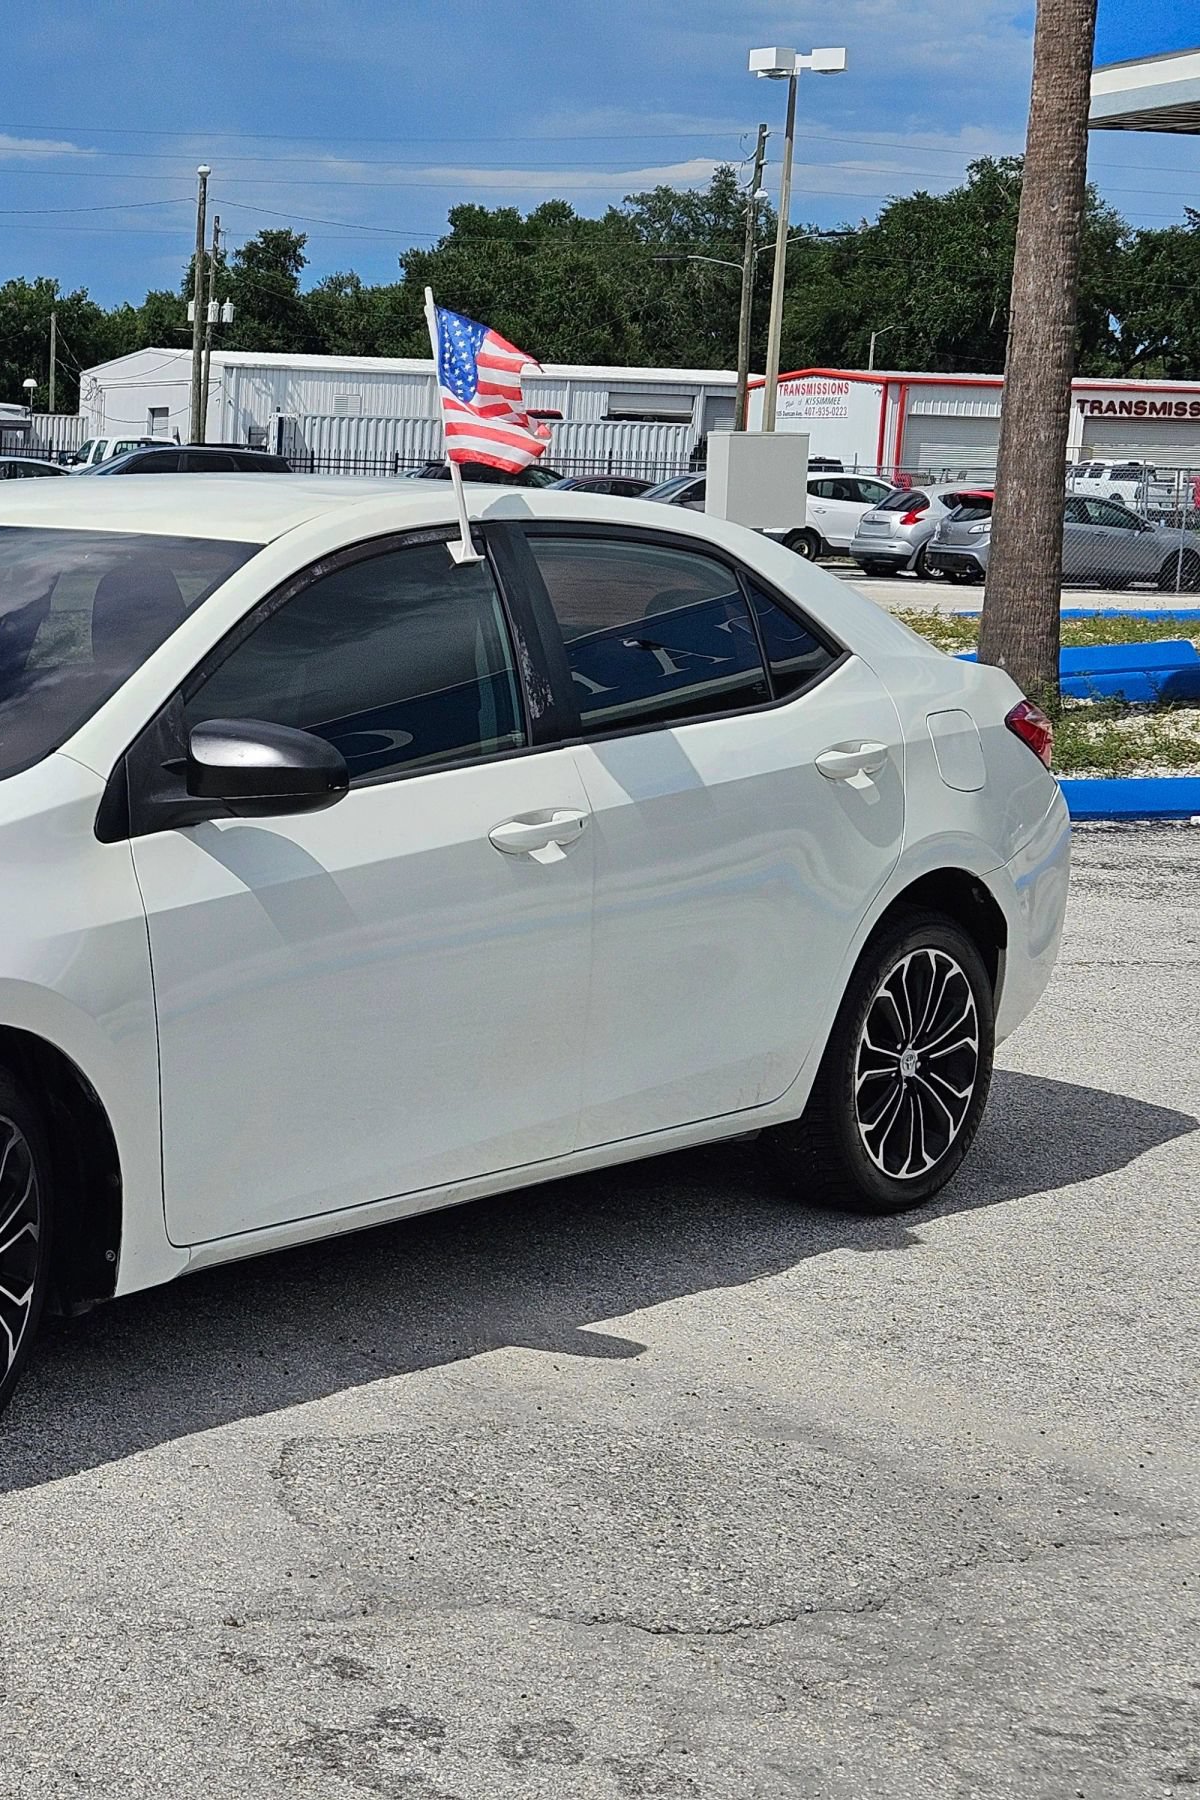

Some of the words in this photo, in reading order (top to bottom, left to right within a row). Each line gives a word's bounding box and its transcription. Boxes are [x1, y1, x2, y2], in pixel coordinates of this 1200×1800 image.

[778, 382, 849, 396] TRANSMISSIONS
[804, 396, 842, 406] KISSIMMEE
[804, 406, 848, 417] 407-935-0223
